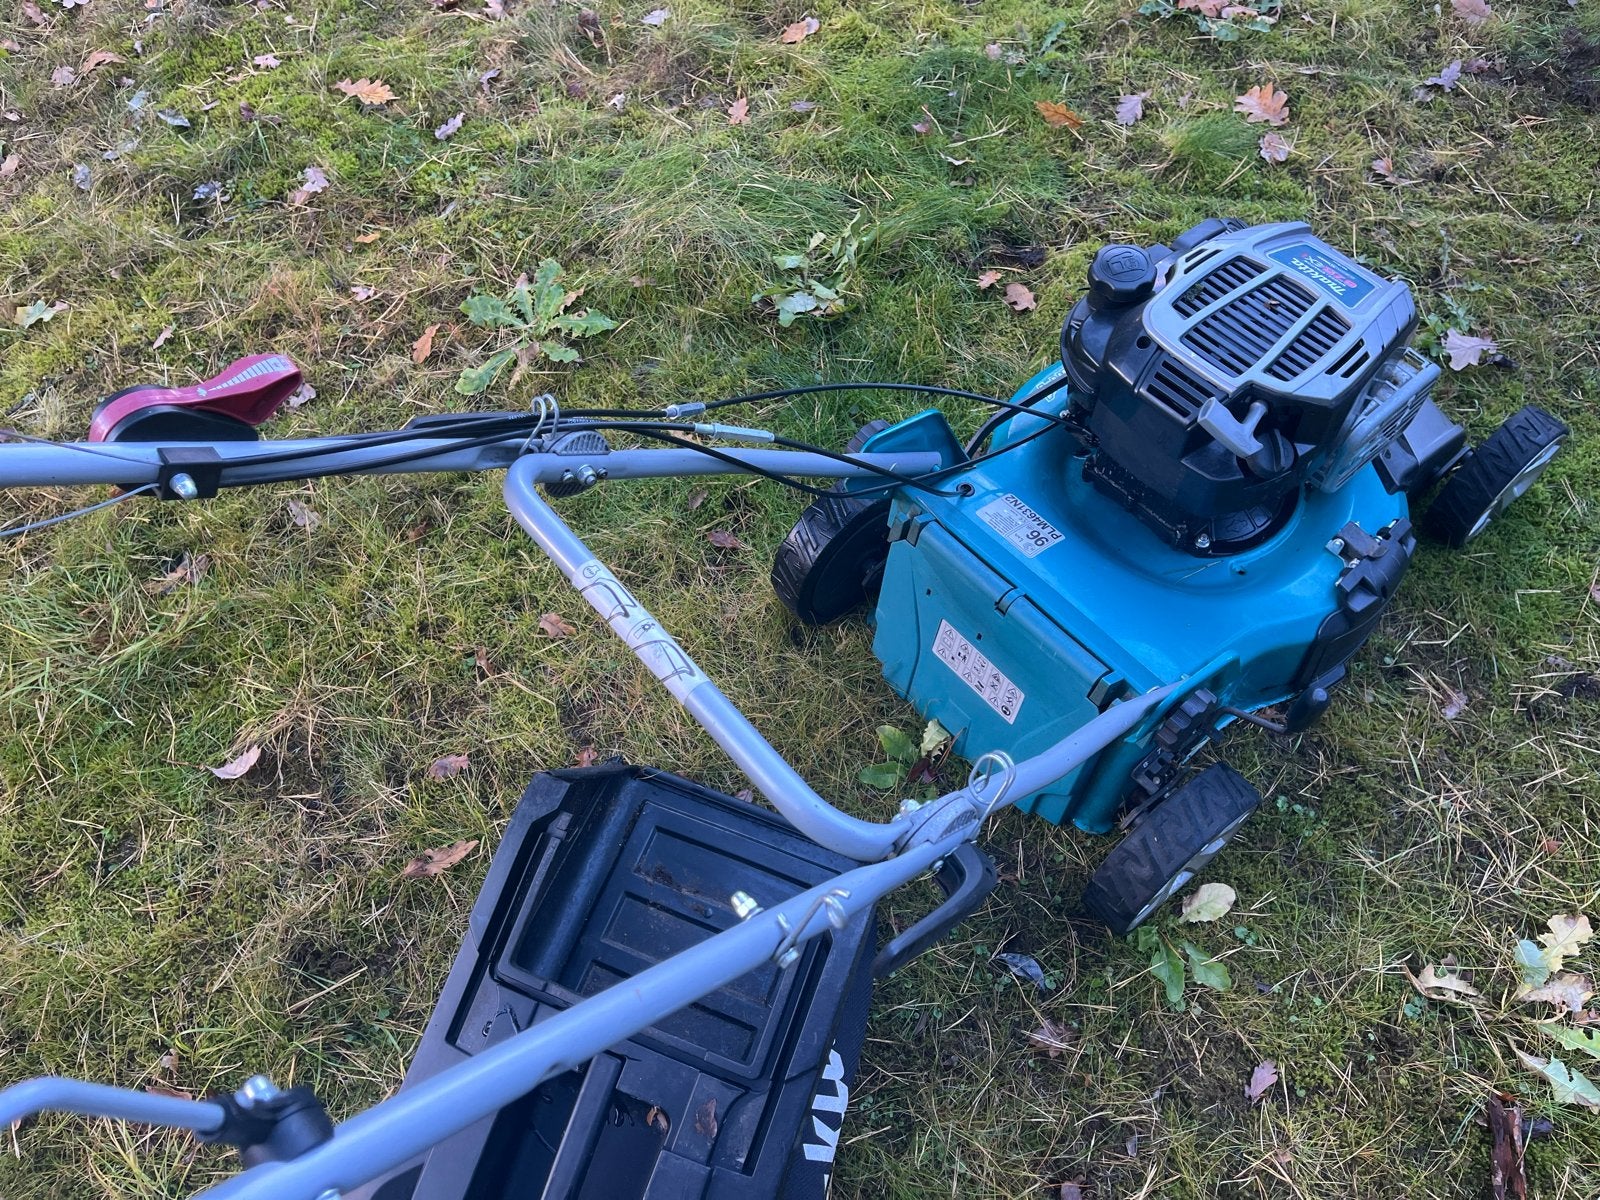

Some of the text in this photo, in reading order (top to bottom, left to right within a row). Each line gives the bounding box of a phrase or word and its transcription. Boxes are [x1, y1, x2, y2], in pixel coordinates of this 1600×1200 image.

[1291, 258, 1345, 295] makita
[1005, 494, 1062, 540] PLM4631N2
[1026, 530, 1049, 547] 96
